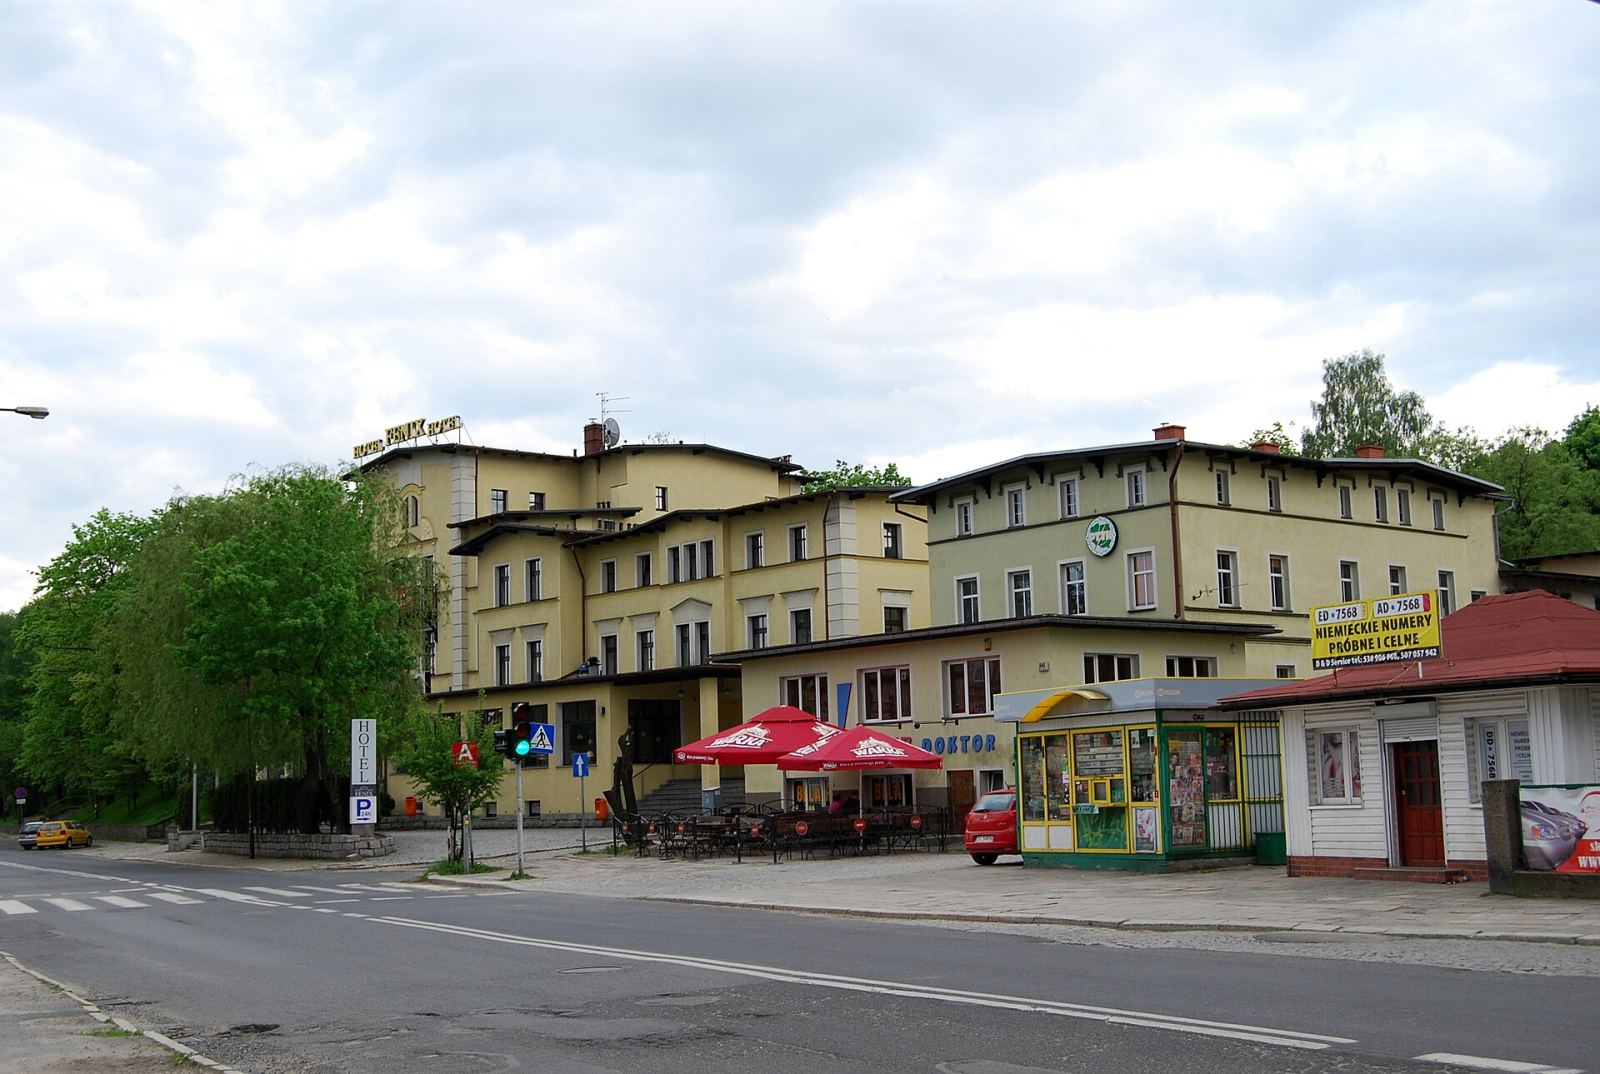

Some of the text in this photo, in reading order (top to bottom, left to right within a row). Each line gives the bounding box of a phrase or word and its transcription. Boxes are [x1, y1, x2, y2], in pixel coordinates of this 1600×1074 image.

[385, 418, 426, 446] FENIX
[427, 415, 463, 436] HOTEL
[1318, 607, 1358, 622] ED 7568
[1377, 598, 1420, 614] AD 7568
[1315, 614, 1433, 639] NIEMIECKIE NUMERY
[1329, 633, 1420, 654] PRÓBNE I CELNE
[1331, 657, 1350, 666] Service
[358, 720, 369, 783] HOTEL
[922, 734, 996, 754] DOKTOR
[1486, 731, 1497, 779] DD 7568
[357, 799, 372, 817] P
